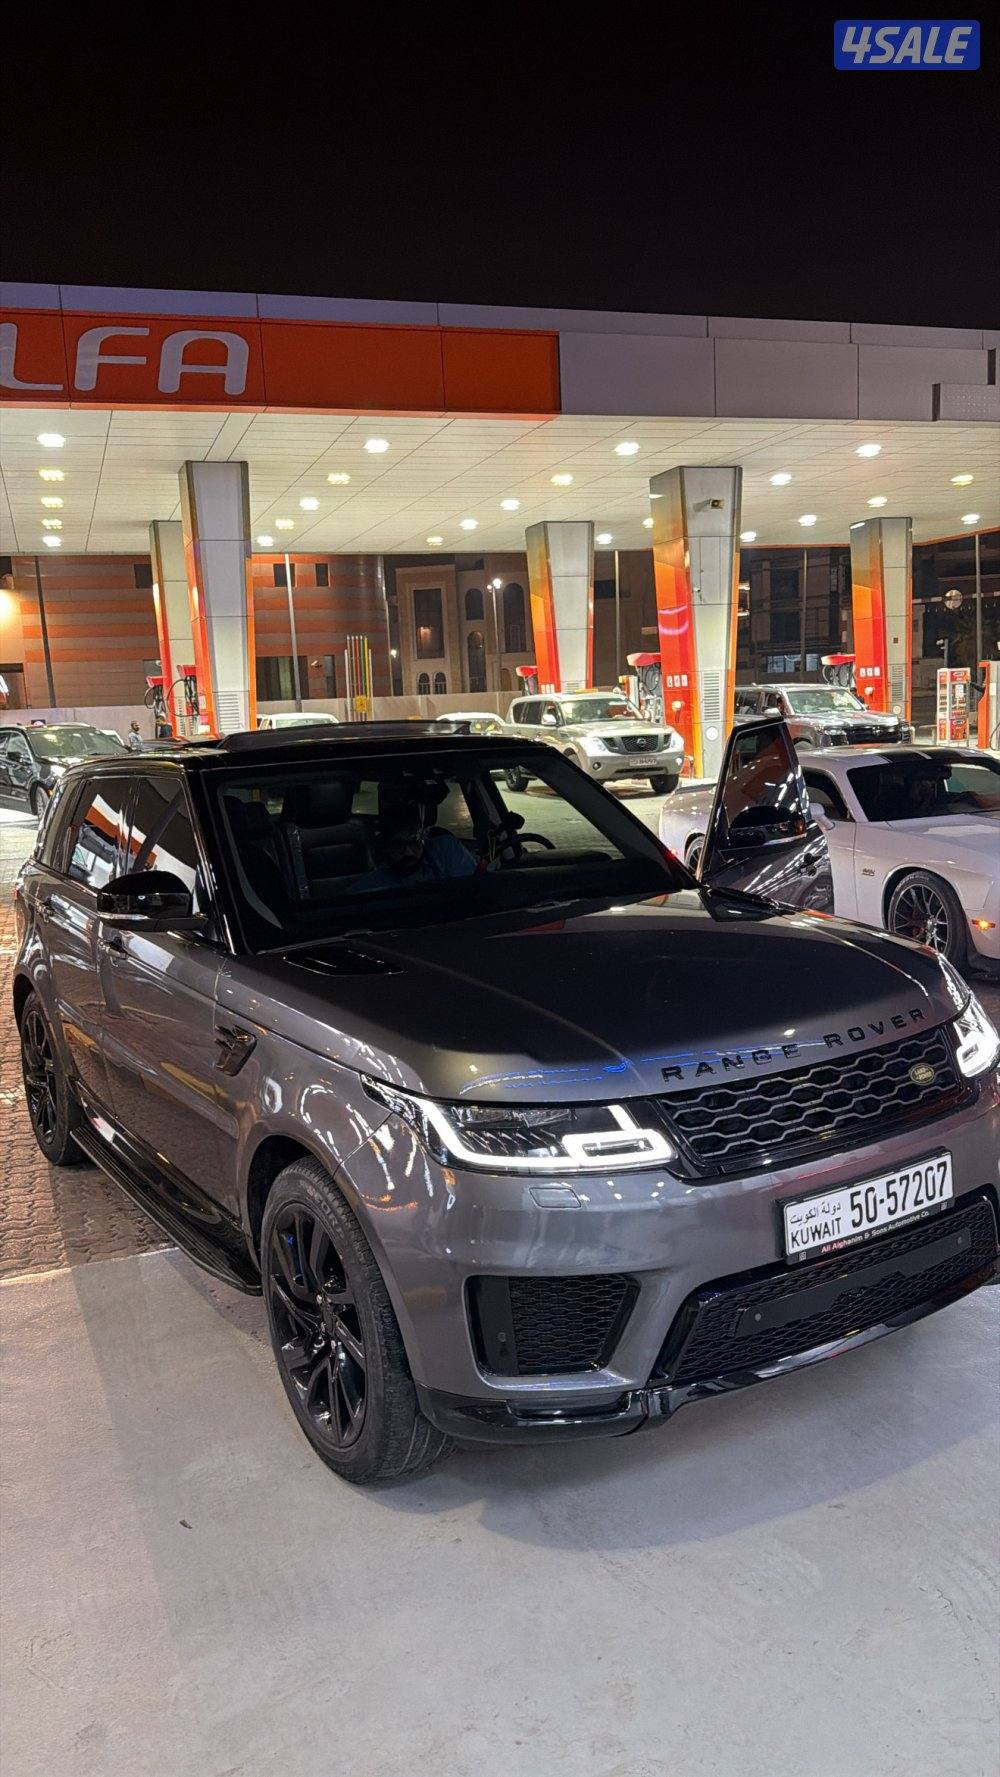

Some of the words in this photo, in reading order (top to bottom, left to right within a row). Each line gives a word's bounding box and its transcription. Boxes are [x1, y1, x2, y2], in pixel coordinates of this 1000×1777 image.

[661, 1043, 801, 1082] RANGE
[823, 1008, 927, 1048] ROVER
[850, 1161, 947, 1228] 50-57207
[790, 1207, 819, 1226] الكويت
[821, 1201, 841, 1216] دولة
[791, 1217, 841, 1248] KUWAIT
[871, 1227, 887, 1237] Sons
[887, 1214, 920, 1232] Automotive
